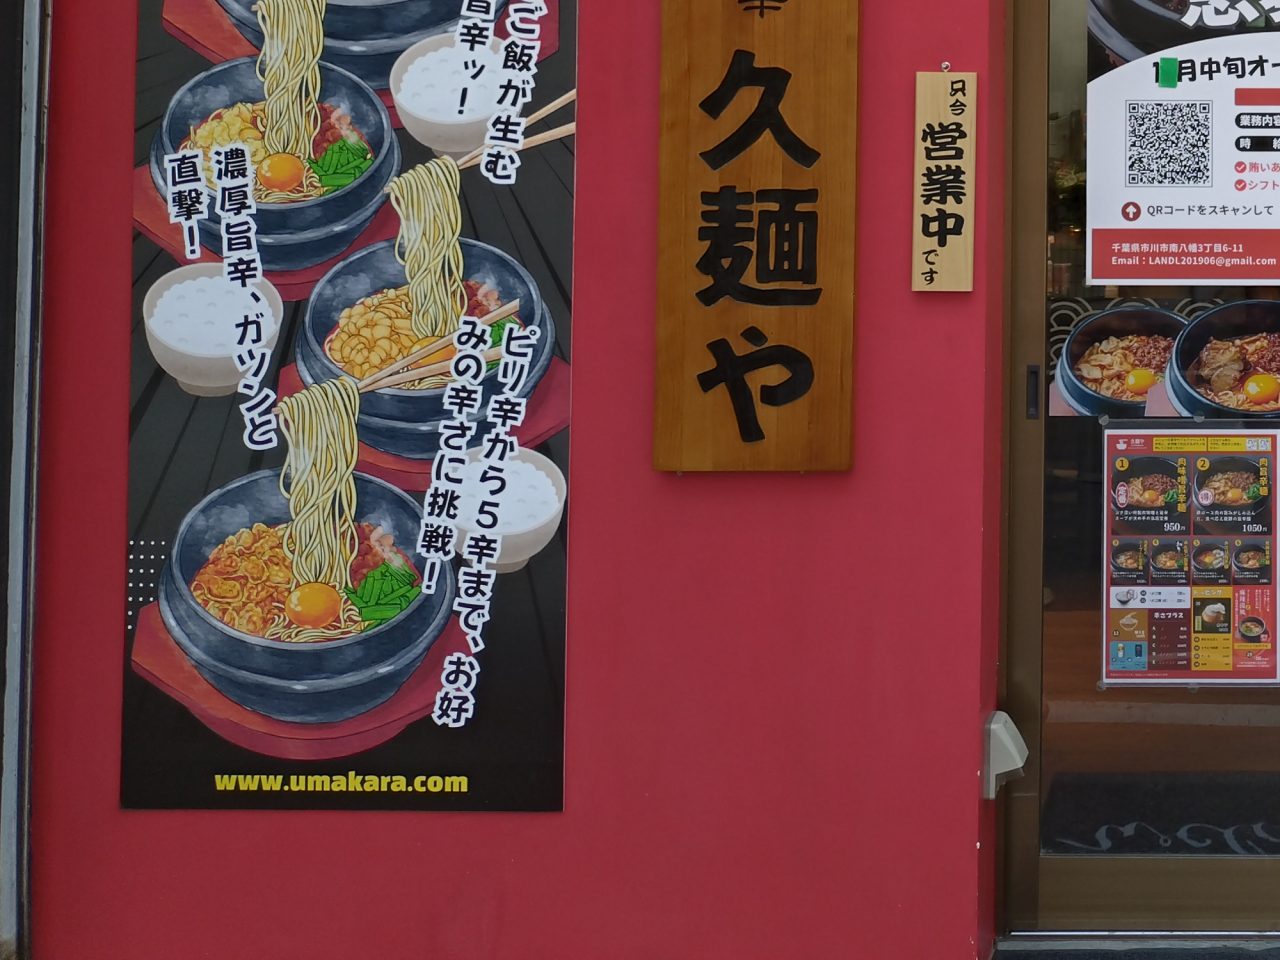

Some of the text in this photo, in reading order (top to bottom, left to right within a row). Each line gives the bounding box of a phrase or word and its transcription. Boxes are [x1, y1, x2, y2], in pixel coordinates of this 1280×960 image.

[168, 153, 204, 255] 直撃！
[695, 48, 822, 443] 久麺や
[921, 121, 967, 247] 営業中
[1147, 205, 1273, 216] QRコードをスキャンして
[214, 147, 275, 445] 濃厚旨辛、ガツンと
[421, 321, 488, 591] みの辛さに挑戦！
[214, 771, 468, 792] www.umakara.com
